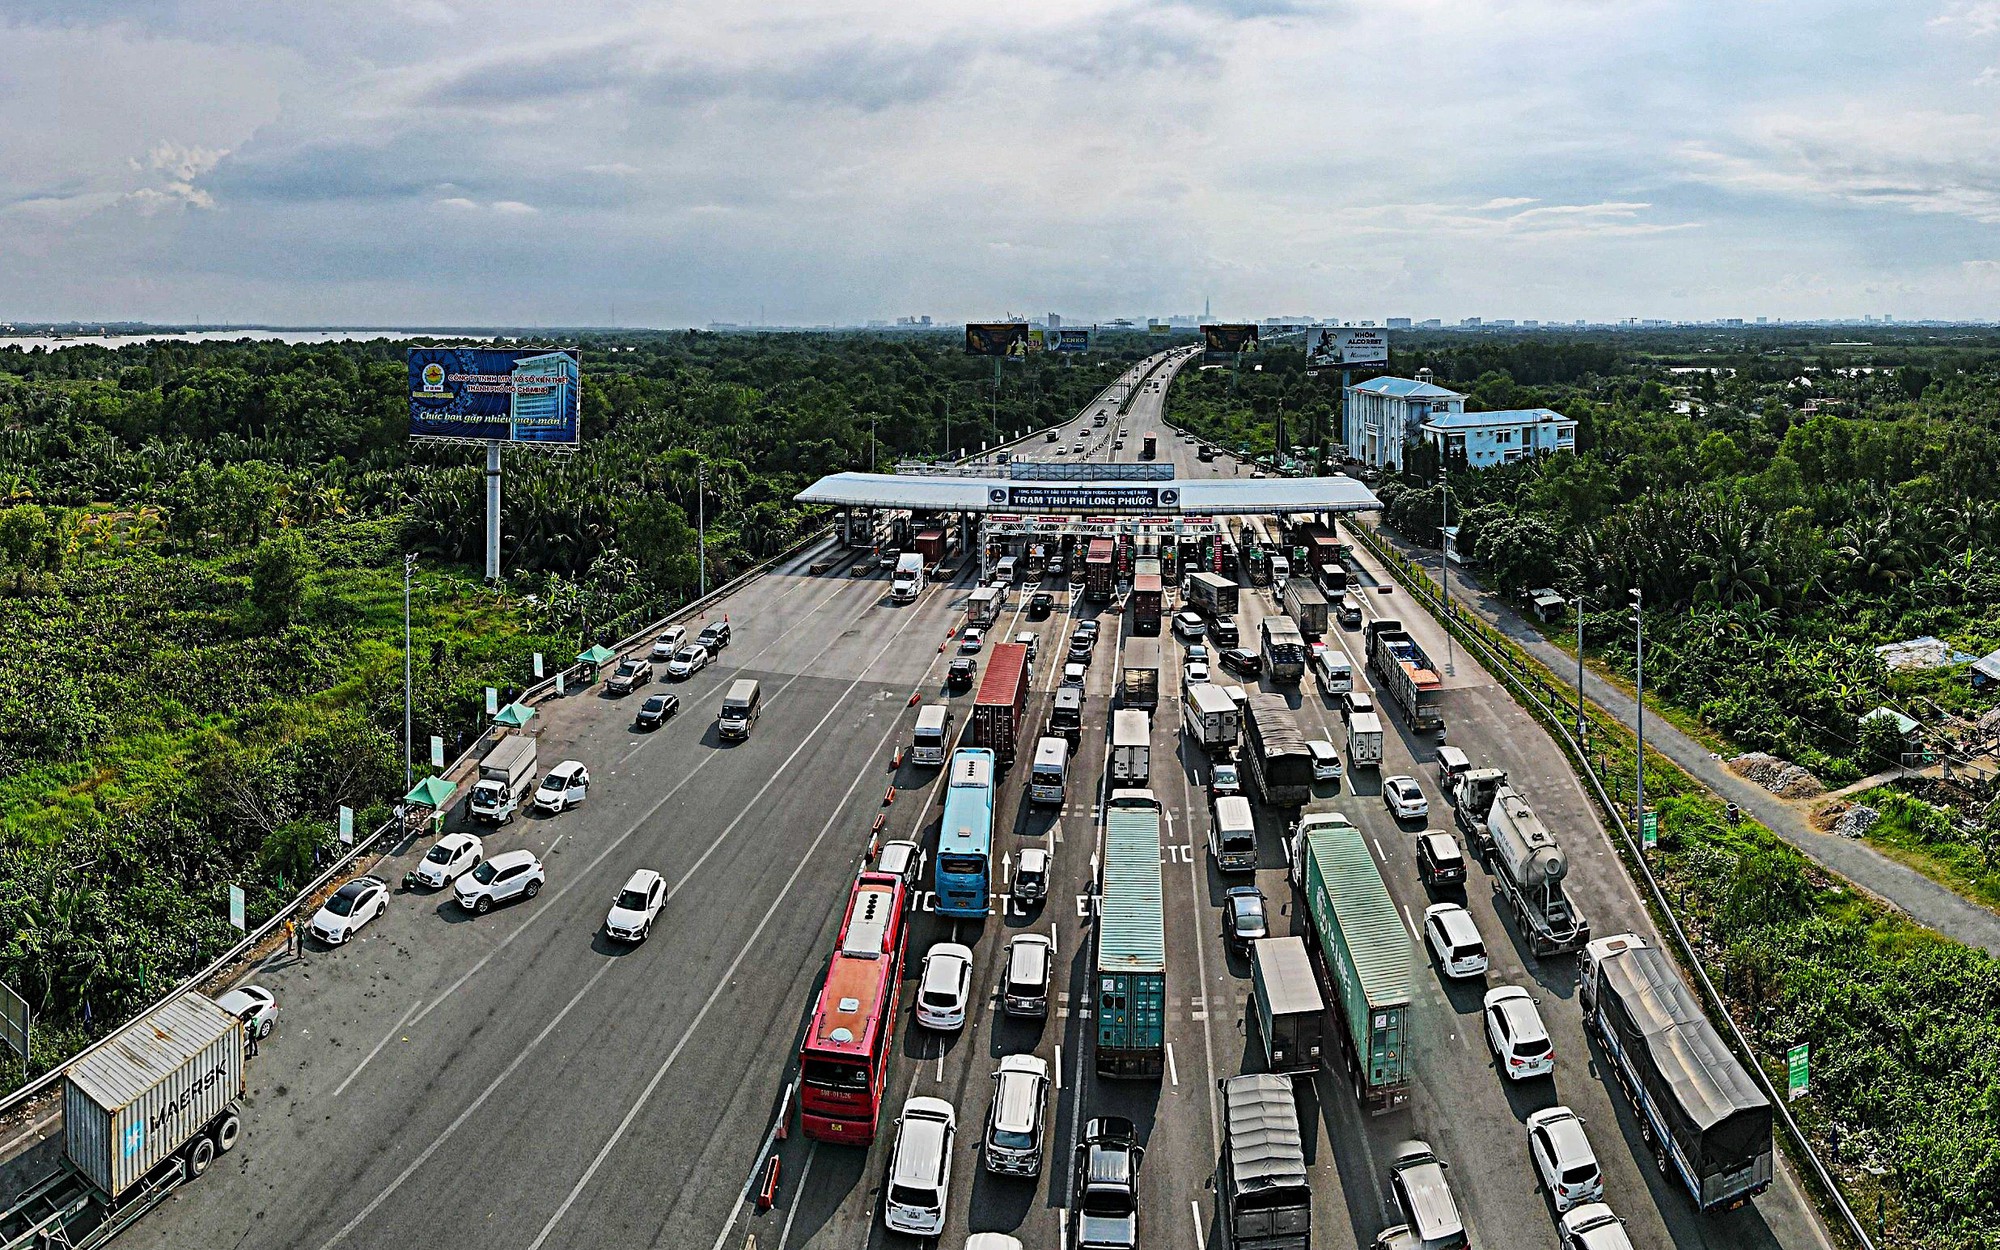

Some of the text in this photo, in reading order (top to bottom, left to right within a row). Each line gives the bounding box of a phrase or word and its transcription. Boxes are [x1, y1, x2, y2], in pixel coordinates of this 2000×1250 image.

[447, 373, 469, 382] CÔNG
[478, 375, 497, 383] TNHH
[420, 411, 443, 420] Chúc
[1013, 494, 1153, 506] TRẠM THU PHÍ LONG PHƯỚC
[149, 1059, 228, 1134] MAERSK
